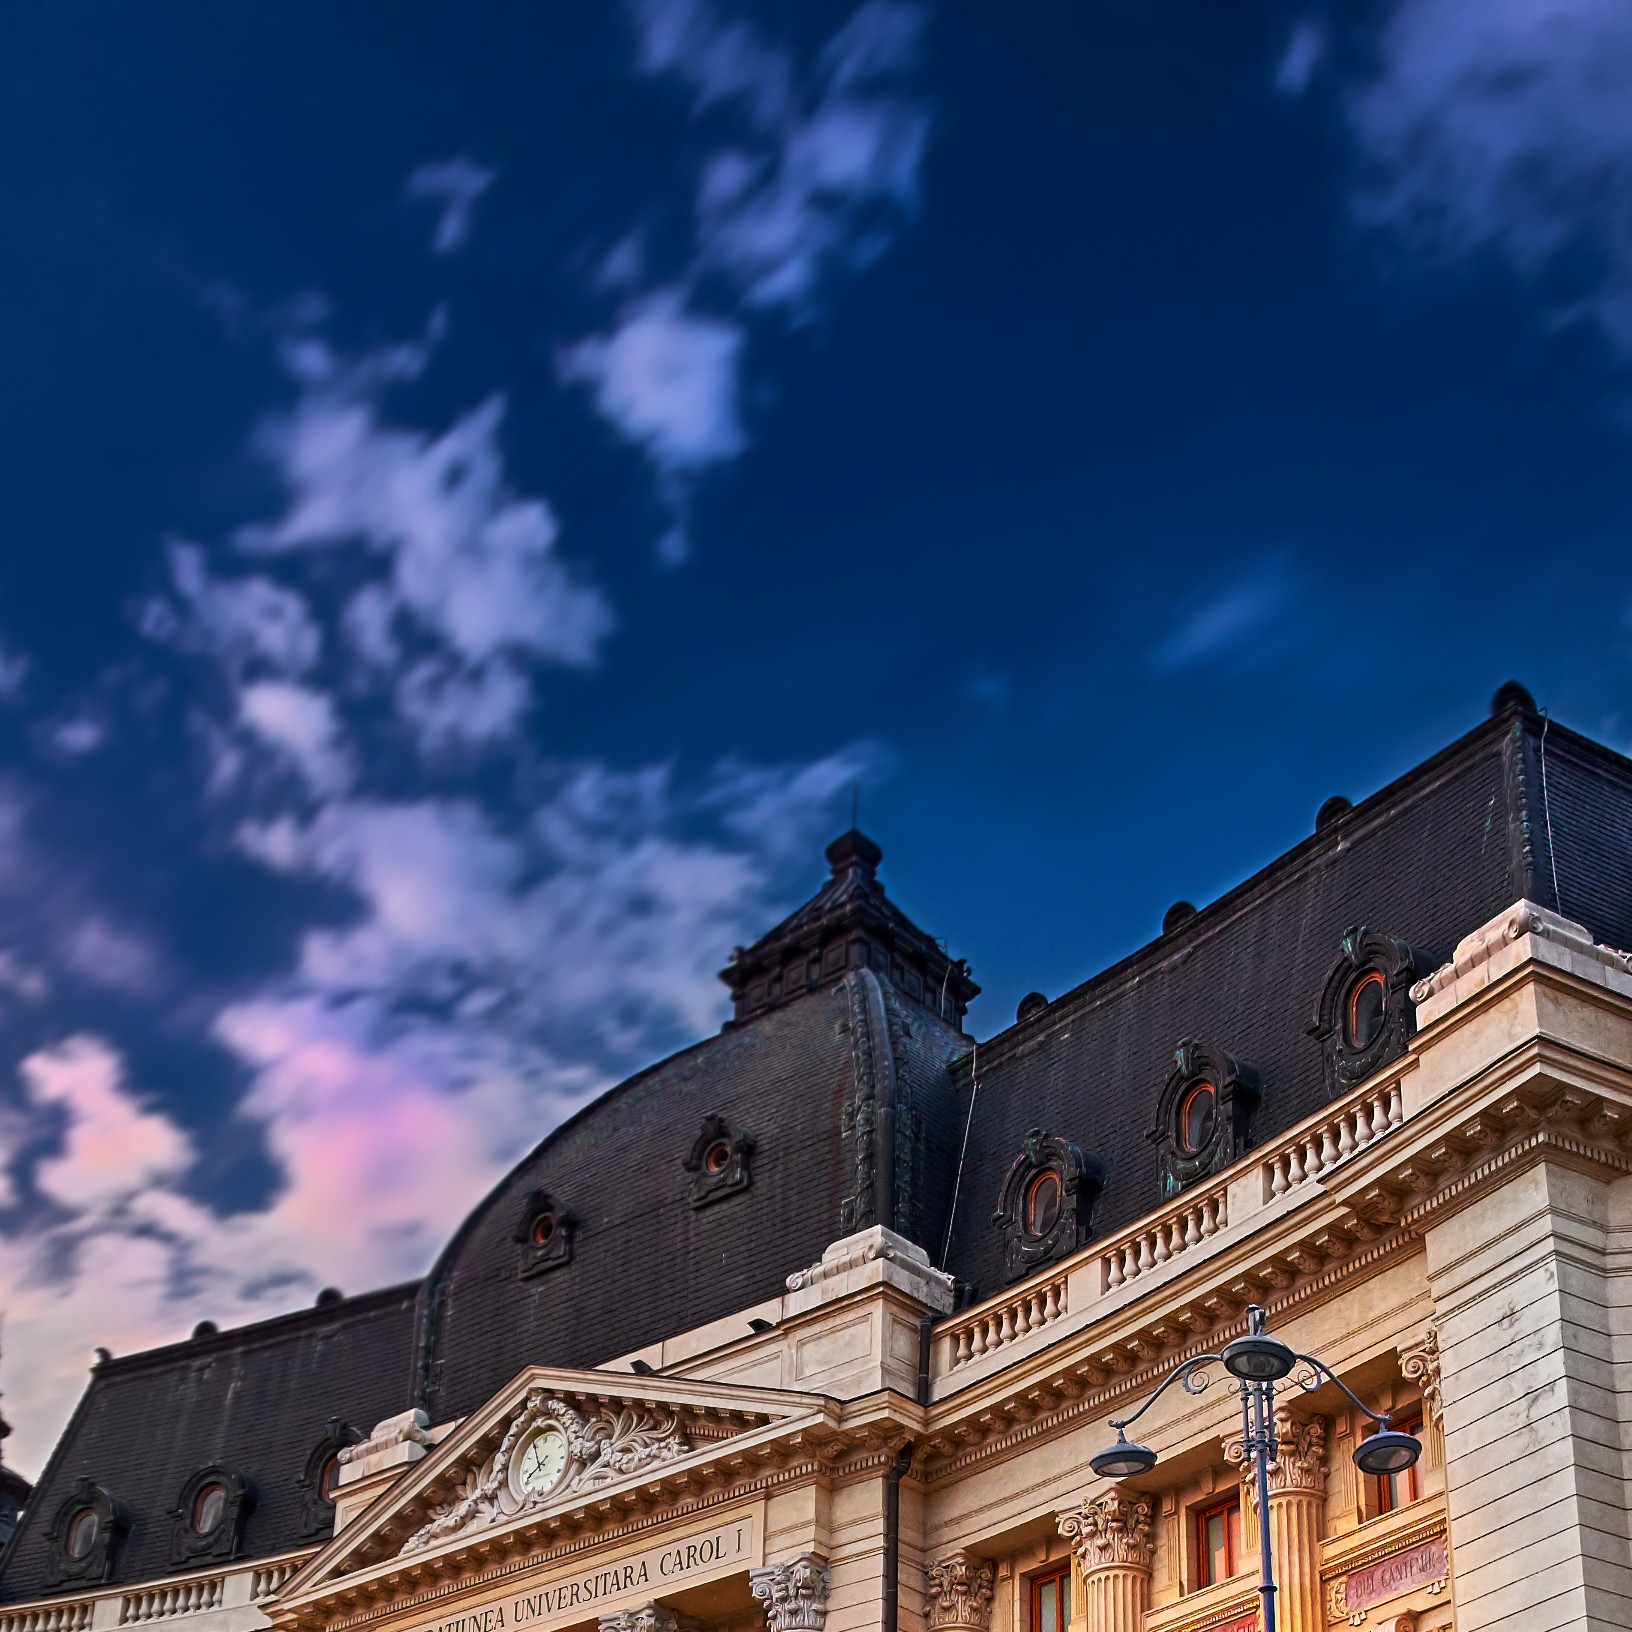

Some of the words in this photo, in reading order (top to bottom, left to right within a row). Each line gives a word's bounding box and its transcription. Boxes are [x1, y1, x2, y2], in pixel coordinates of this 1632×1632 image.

[514, 1560, 649, 1623] UNIVERSITARA
[660, 1535, 727, 1576] CAROL
[735, 1528, 743, 1554] I
